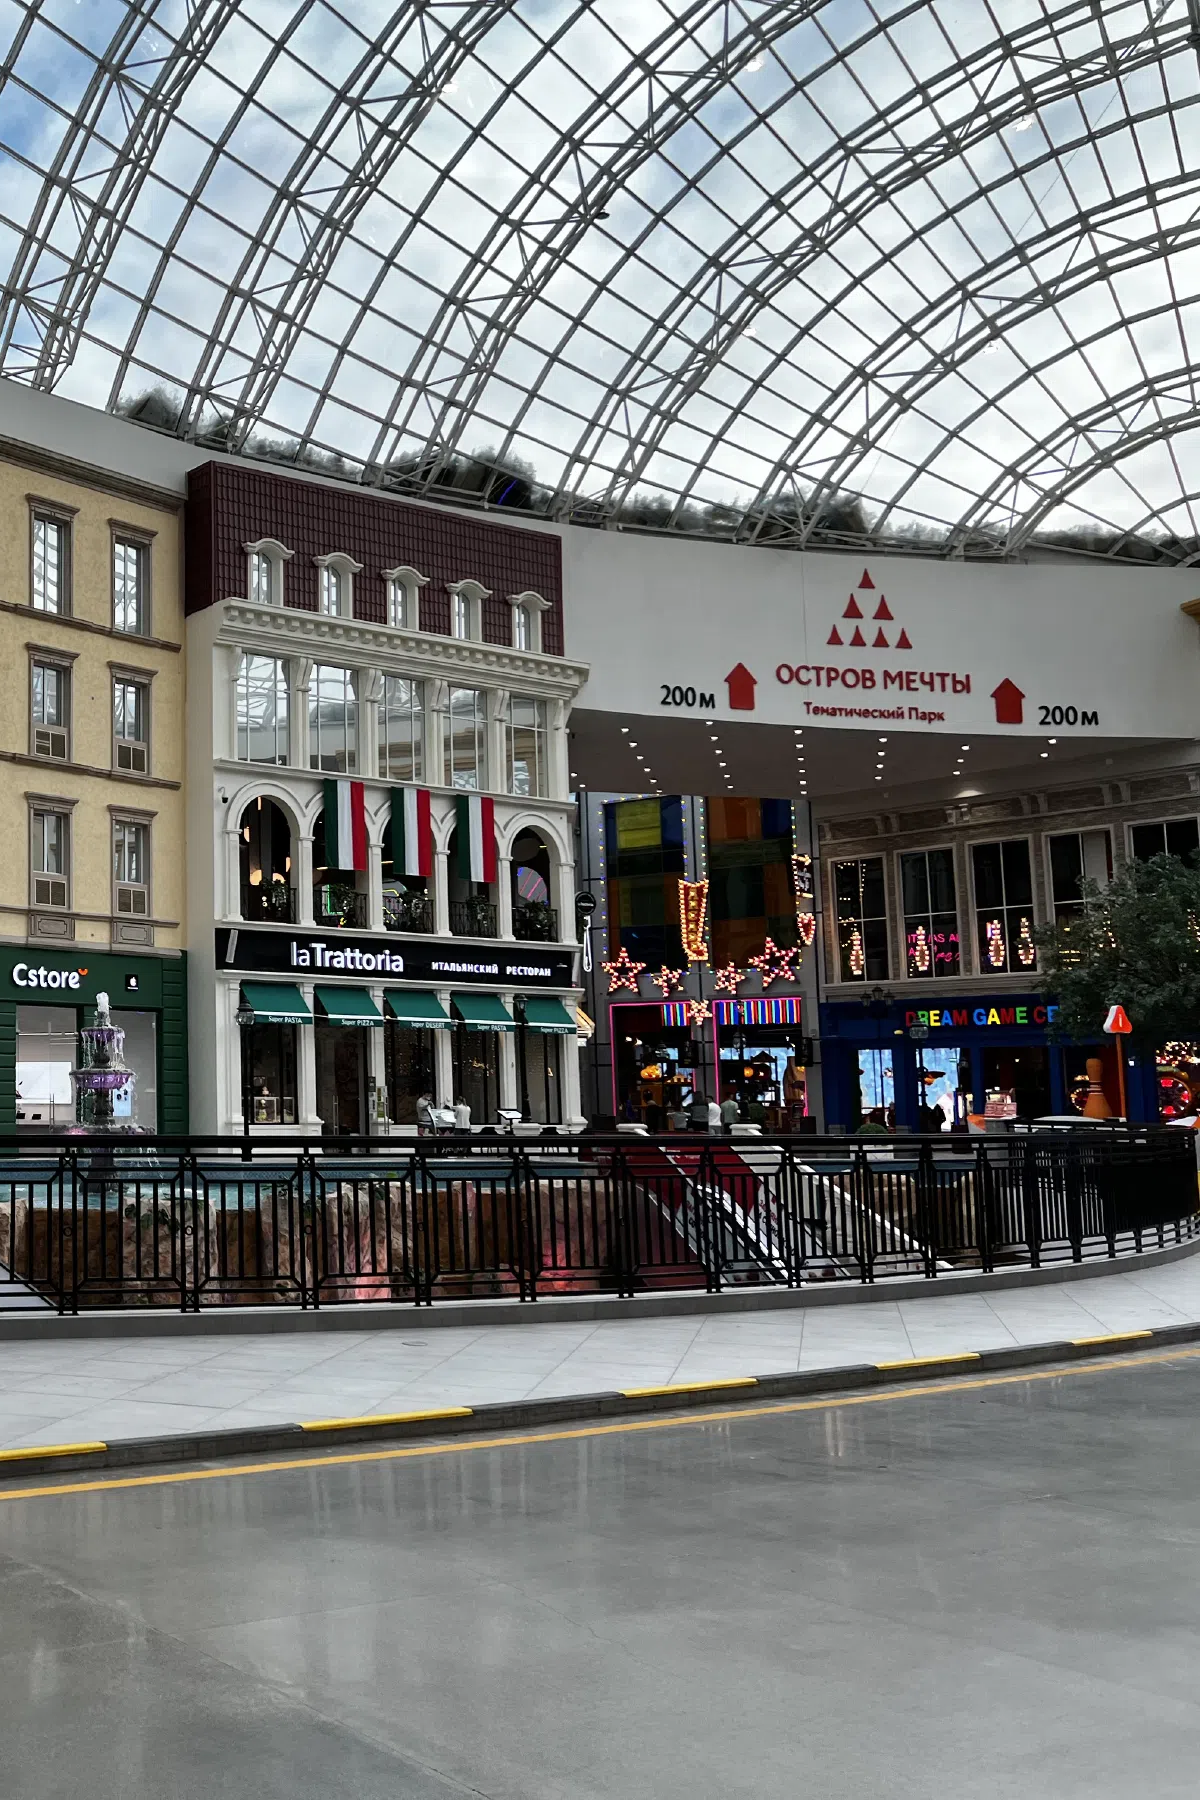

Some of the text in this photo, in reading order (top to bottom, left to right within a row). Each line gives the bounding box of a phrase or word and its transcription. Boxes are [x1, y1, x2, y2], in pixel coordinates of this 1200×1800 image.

[776, 663, 972, 694] ОСТРОВ МЕЧТЫ
[660, 684, 697, 707] 200
[803, 701, 945, 725] Тематический Парк
[1038, 705, 1079, 726] 200
[309, 943, 404, 973] Trattoria
[431, 960, 552, 977] ИТАЛЬЯНСКИЙ РЕСТОРАН
[12, 963, 81, 989] Cstore
[284, 1016, 303, 1024] PASTA
[356, 1019, 374, 1027] PIZZA
[425, 1021, 445, 1029] DESERT
[905, 1009, 968, 1027] DREAM
[973, 1006, 1028, 1025] GAME
